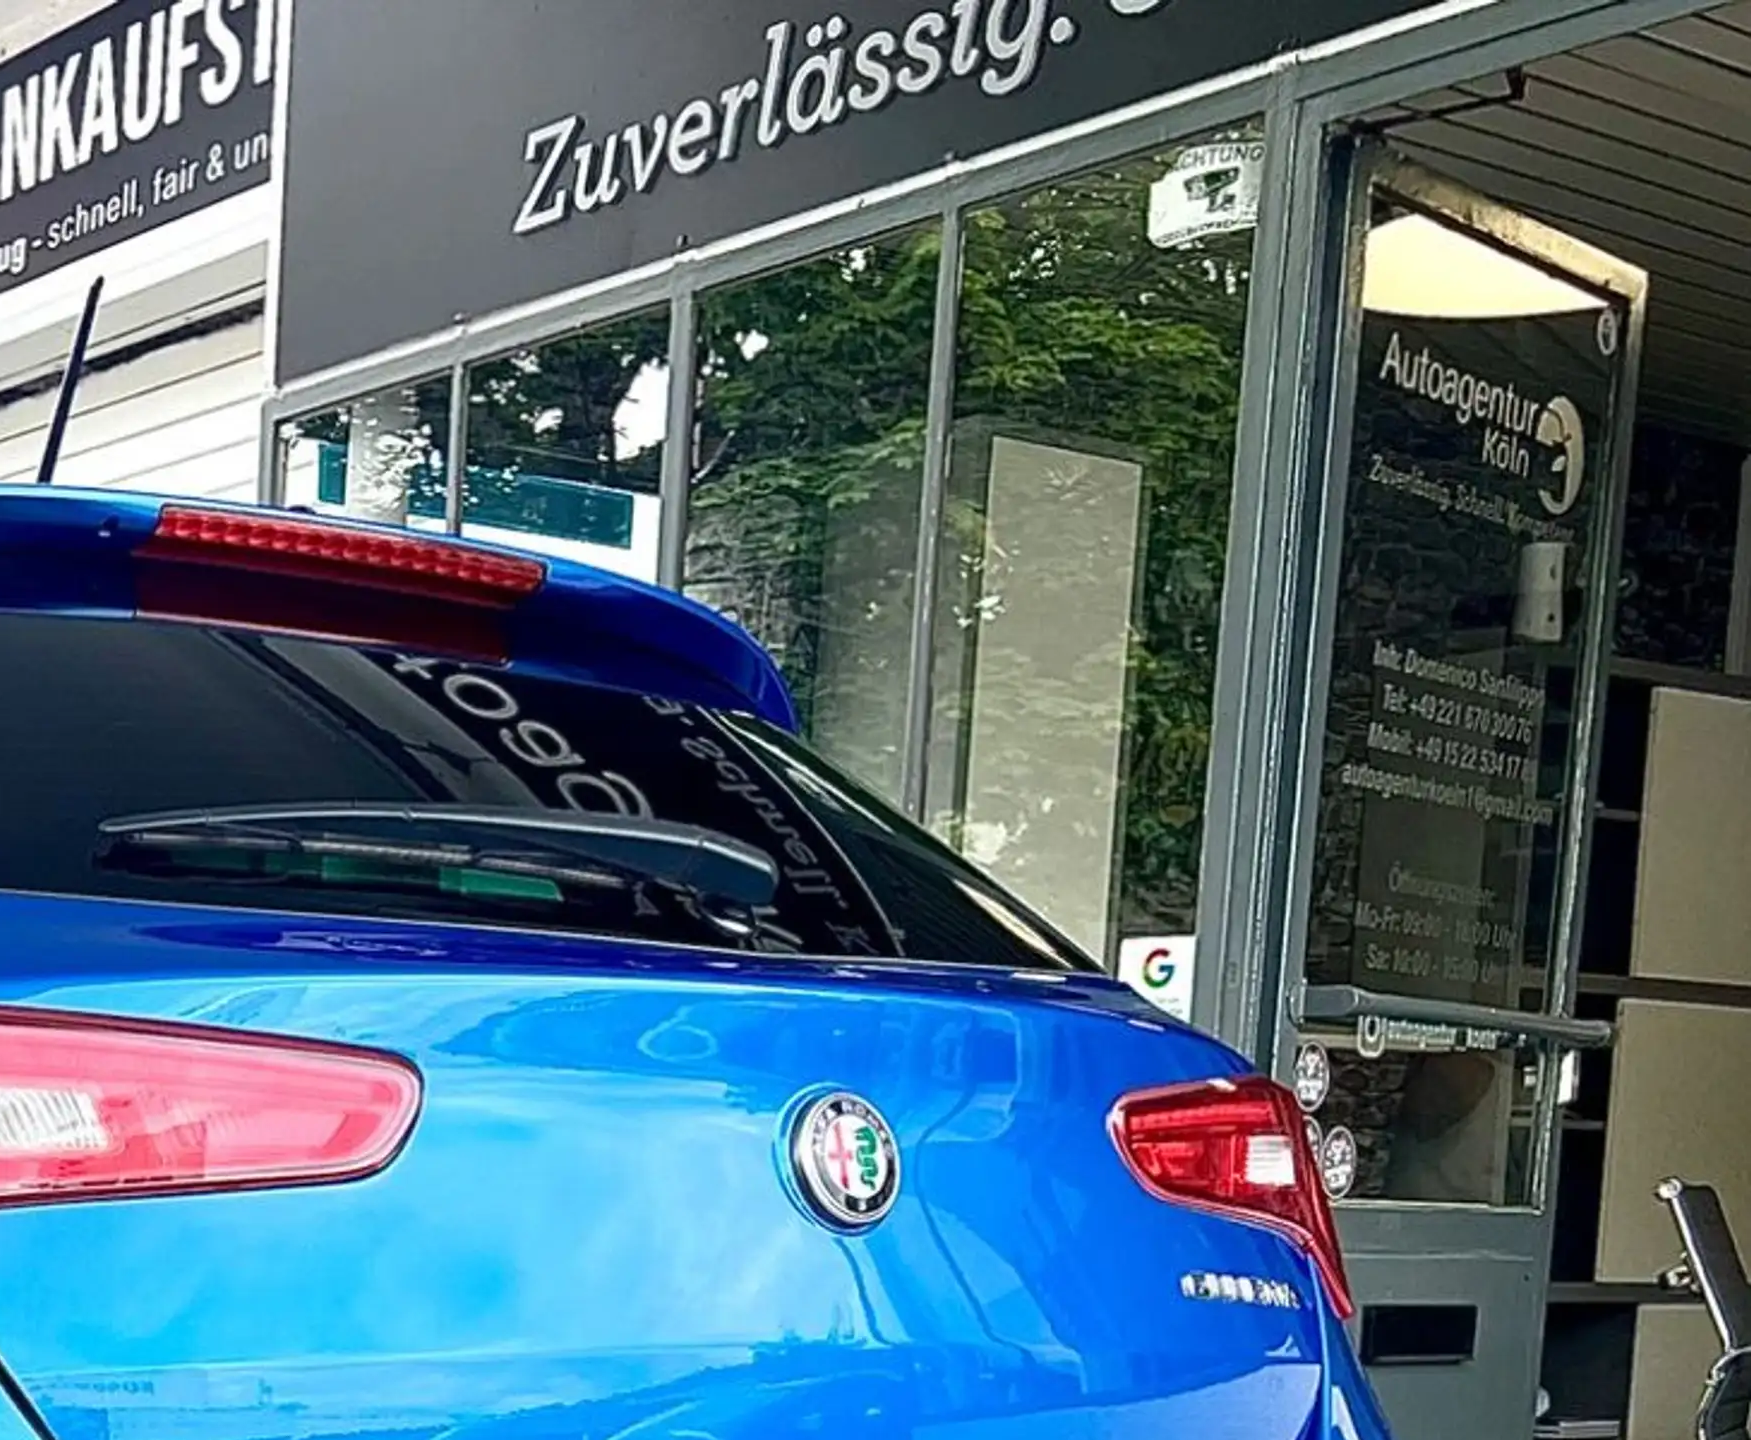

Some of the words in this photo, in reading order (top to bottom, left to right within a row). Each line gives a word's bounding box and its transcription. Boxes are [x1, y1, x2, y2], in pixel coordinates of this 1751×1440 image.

[512, 0, 1076, 235] Zuverlässig.
[46, 178, 145, 250] schnell,
[153, 157, 201, 206] fair
[206, 142, 226, 183] &
[1379, 331, 1540, 436] Autoagentur
[1481, 426, 1530, 479] Köln
